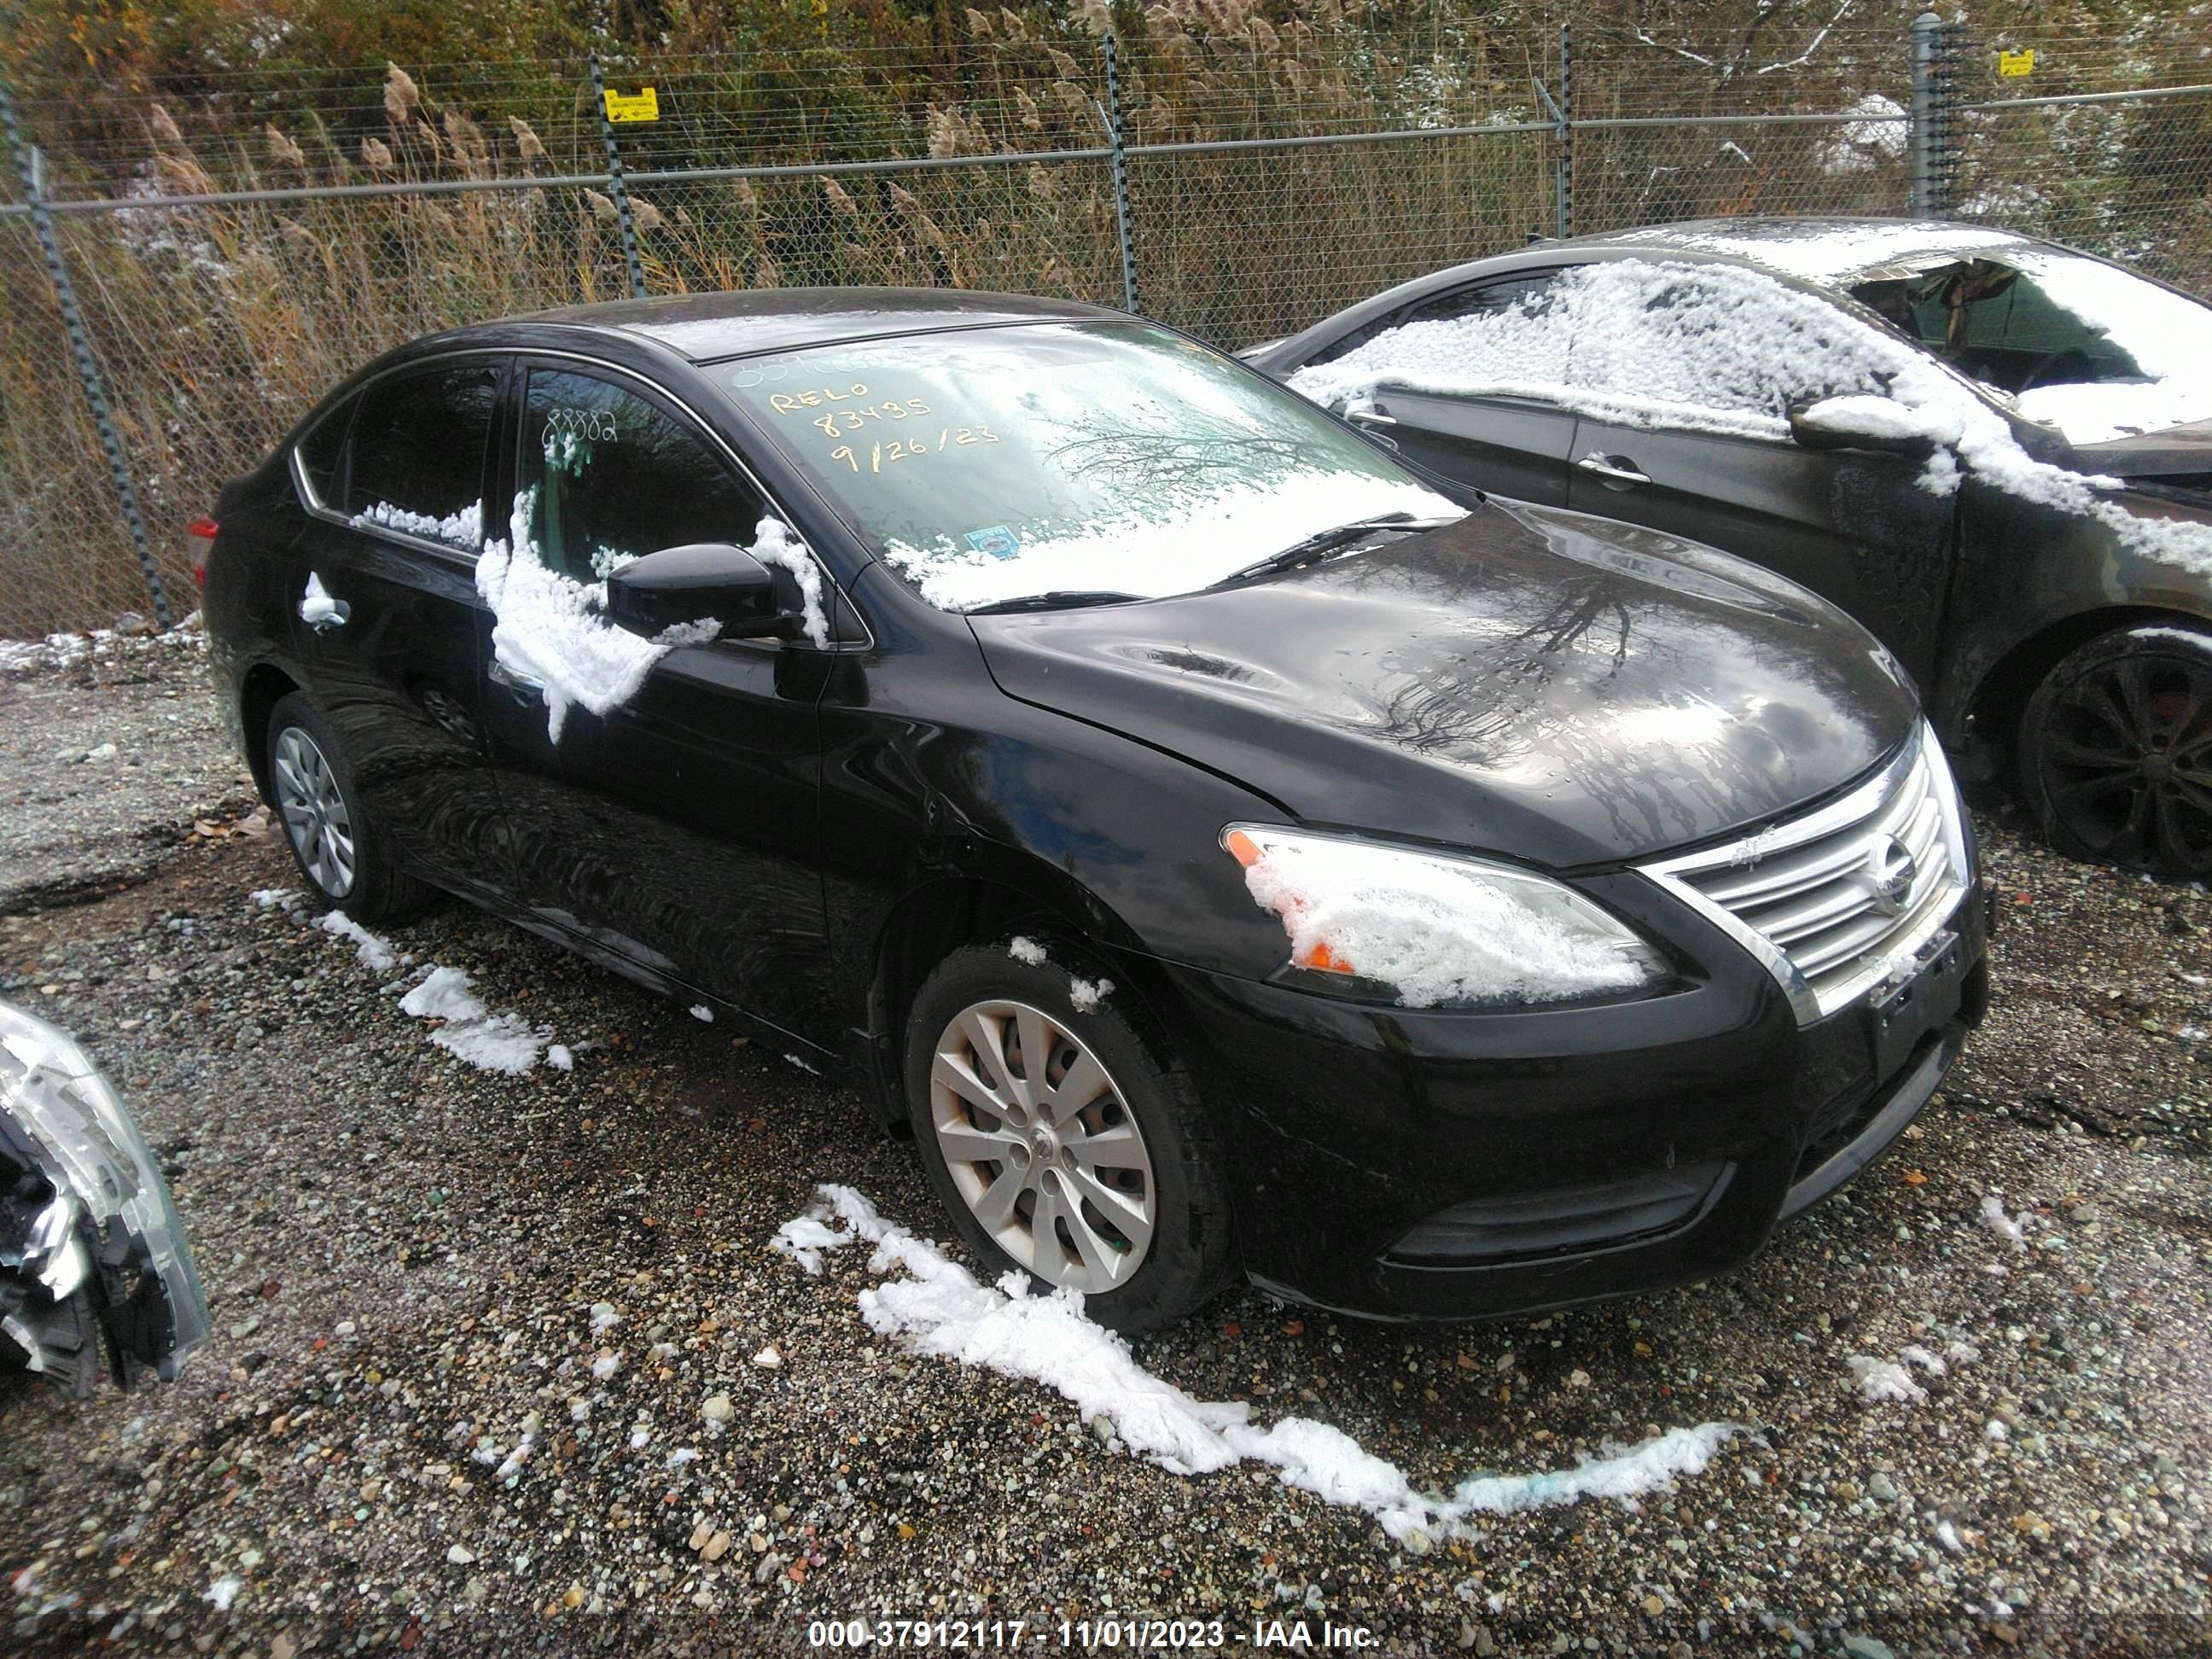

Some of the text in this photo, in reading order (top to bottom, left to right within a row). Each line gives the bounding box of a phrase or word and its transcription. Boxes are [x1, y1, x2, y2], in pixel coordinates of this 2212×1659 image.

[770, 383, 868, 415] RELO
[541, 408, 617, 449] 88882
[830, 427, 999, 473] 9/26/23
